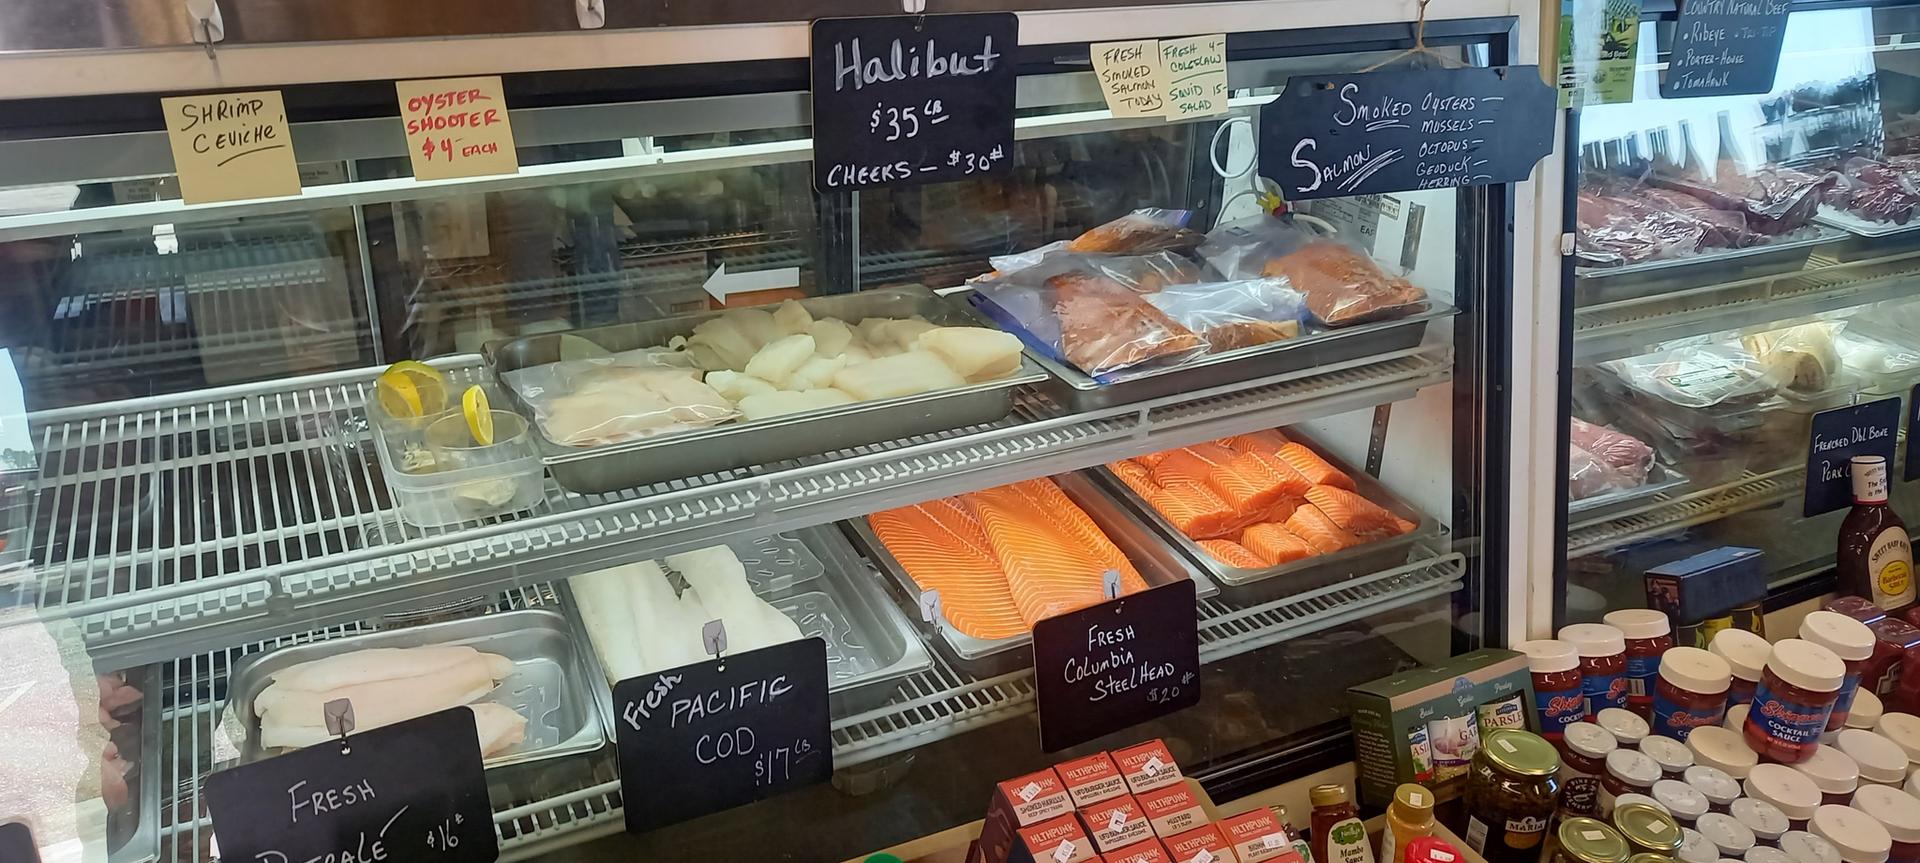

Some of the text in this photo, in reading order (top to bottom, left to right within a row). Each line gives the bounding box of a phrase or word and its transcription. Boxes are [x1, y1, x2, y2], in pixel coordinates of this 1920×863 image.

[1765, 0, 1789, 15] BEEF
[1103, 44, 1143, 66] FRESH
[1163, 44, 1198, 60] FRESH
[834, 35, 1001, 92] Halibut
[1102, 65, 1151, 83] SMOKED
[1170, 54, 1222, 73] COLESLAW
[1111, 80, 1156, 94] SALMON
[1169, 83, 1203, 101] SQUID
[408, 88, 491, 115] OYSTER
[1120, 93, 1163, 111] TODAY
[1180, 100, 1212, 114] SALAD
[1333, 83, 1476, 127] SMOKED OYSTERS
[407, 109, 501, 135] SHOOTER
[870, 102, 920, 141] $35
[1420, 119, 1474, 133] MUSSELS
[462, 142, 498, 158] EACH
[1418, 140, 1469, 158] OCTOPUS
[827, 161, 912, 187] CHEEKS
[1290, 137, 1372, 192] SALMON
[1416, 156, 1472, 177] GEODUCK
[1418, 174, 1470, 190] HERRING
[1821, 459, 1843, 483] PORK
[1088, 624, 1136, 652] FRESH
[623, 673, 683, 731] Fresh
[671, 675, 793, 728] PACIFIC
[1483, 711, 1522, 728] PARSLE
[1768, 720, 1809, 737] COCKTAIL
[696, 727, 755, 764] COD
[1772, 730, 1801, 743] SAUCE
[755, 748, 789, 786] $17
[1066, 761, 1109, 780] HLTHPUNK
[288, 779, 376, 823] FRESH
[1147, 792, 1189, 811] HLTHPUNK
[1030, 822, 1075, 844] HLTHPUNK
[1174, 832, 1217, 853] HLTHPUNK
